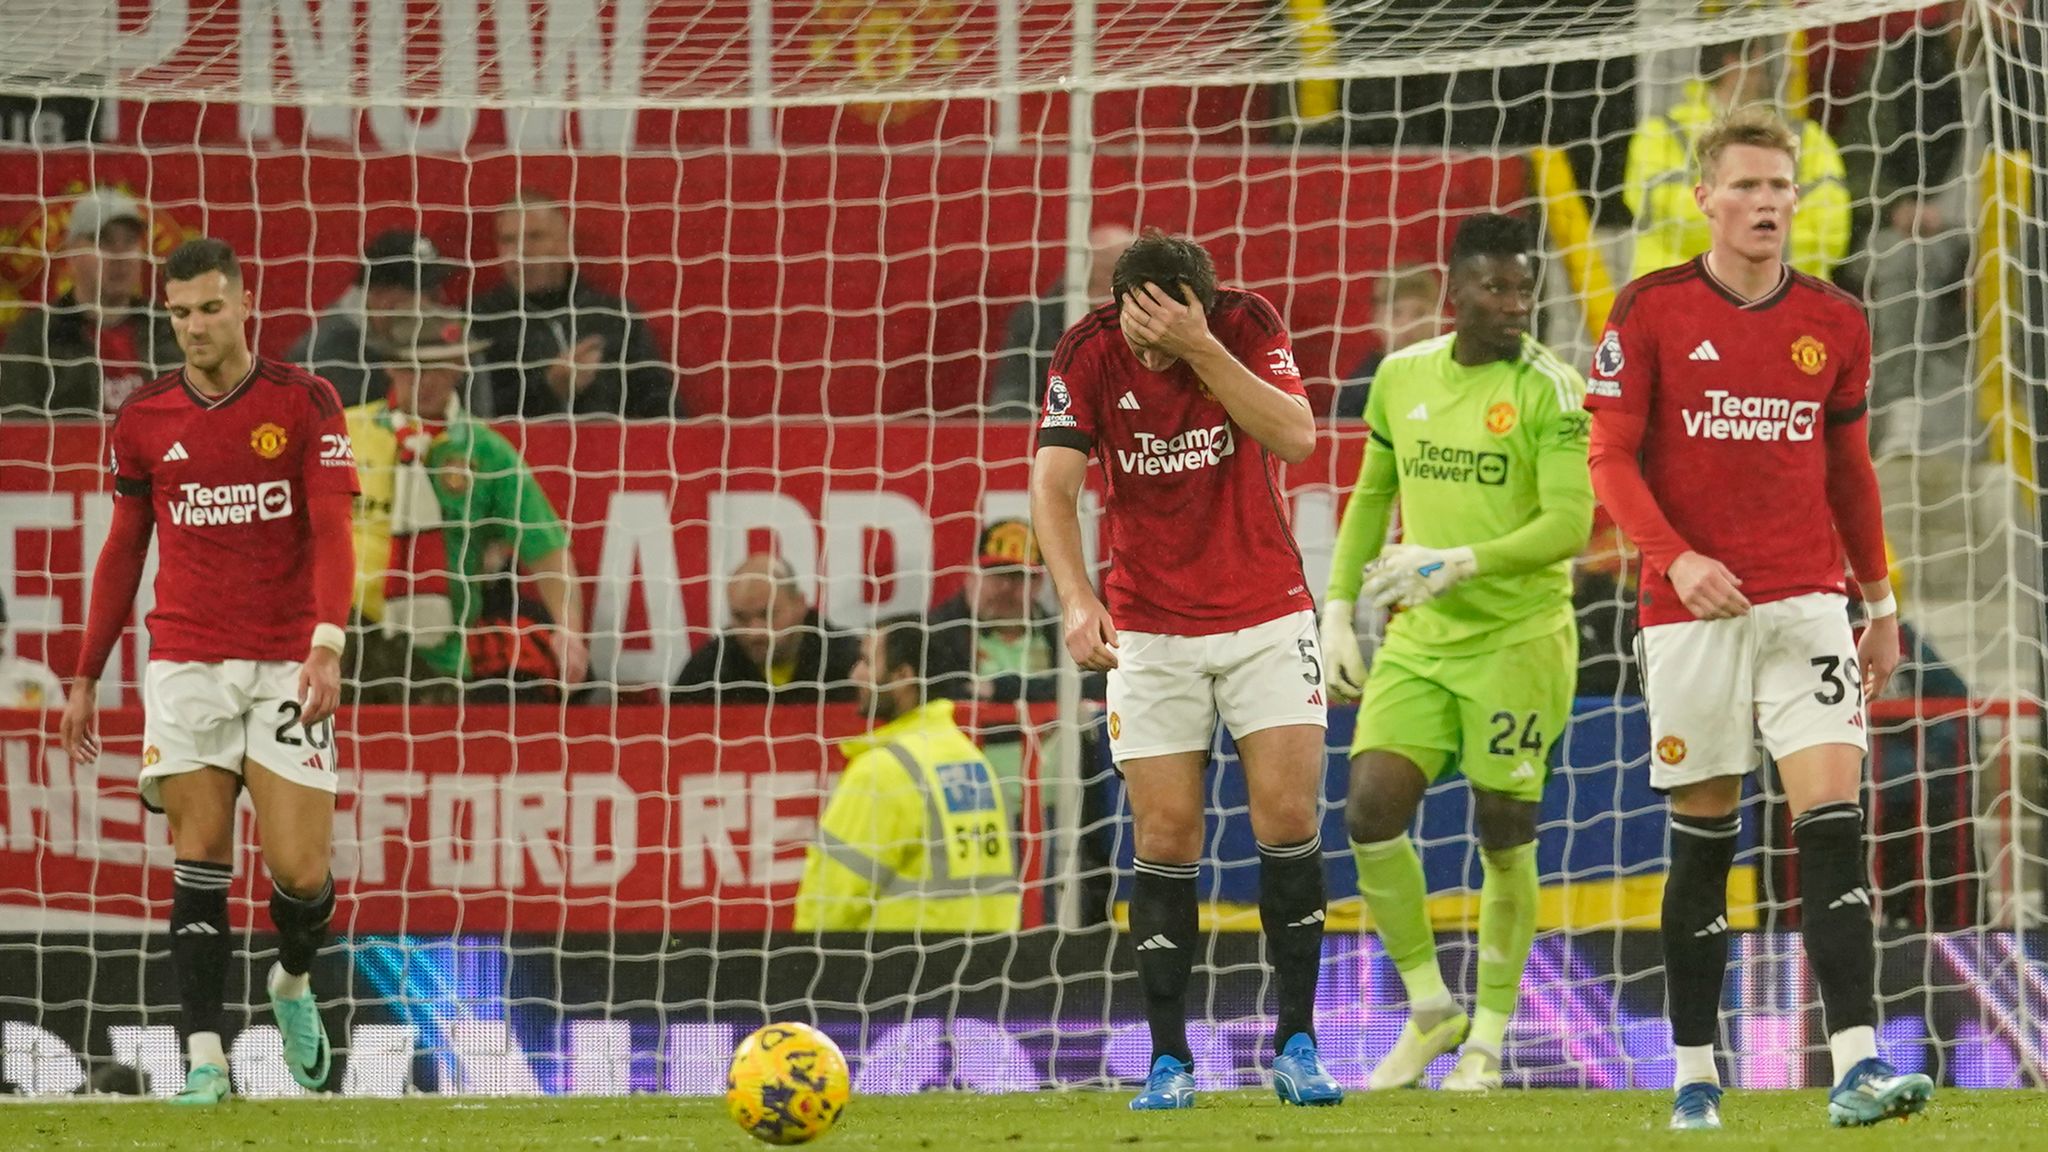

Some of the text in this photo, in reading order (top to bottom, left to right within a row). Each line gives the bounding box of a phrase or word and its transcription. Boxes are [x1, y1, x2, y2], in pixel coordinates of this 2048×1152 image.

[1704, 390, 1789, 419] Team
[1681, 408, 1786, 441] Viewer
[1133, 428, 1209, 455] Team
[1416, 440, 1474, 465] Team
[1117, 449, 1208, 475] Viewer
[1403, 457, 1473, 482] Viewer
[180, 482, 256, 507] Team
[168, 501, 257, 527] Viewer
[1297, 638, 1321, 686] 5
[1810, 654, 1862, 707] 39
[1488, 711, 1543, 757] 24
